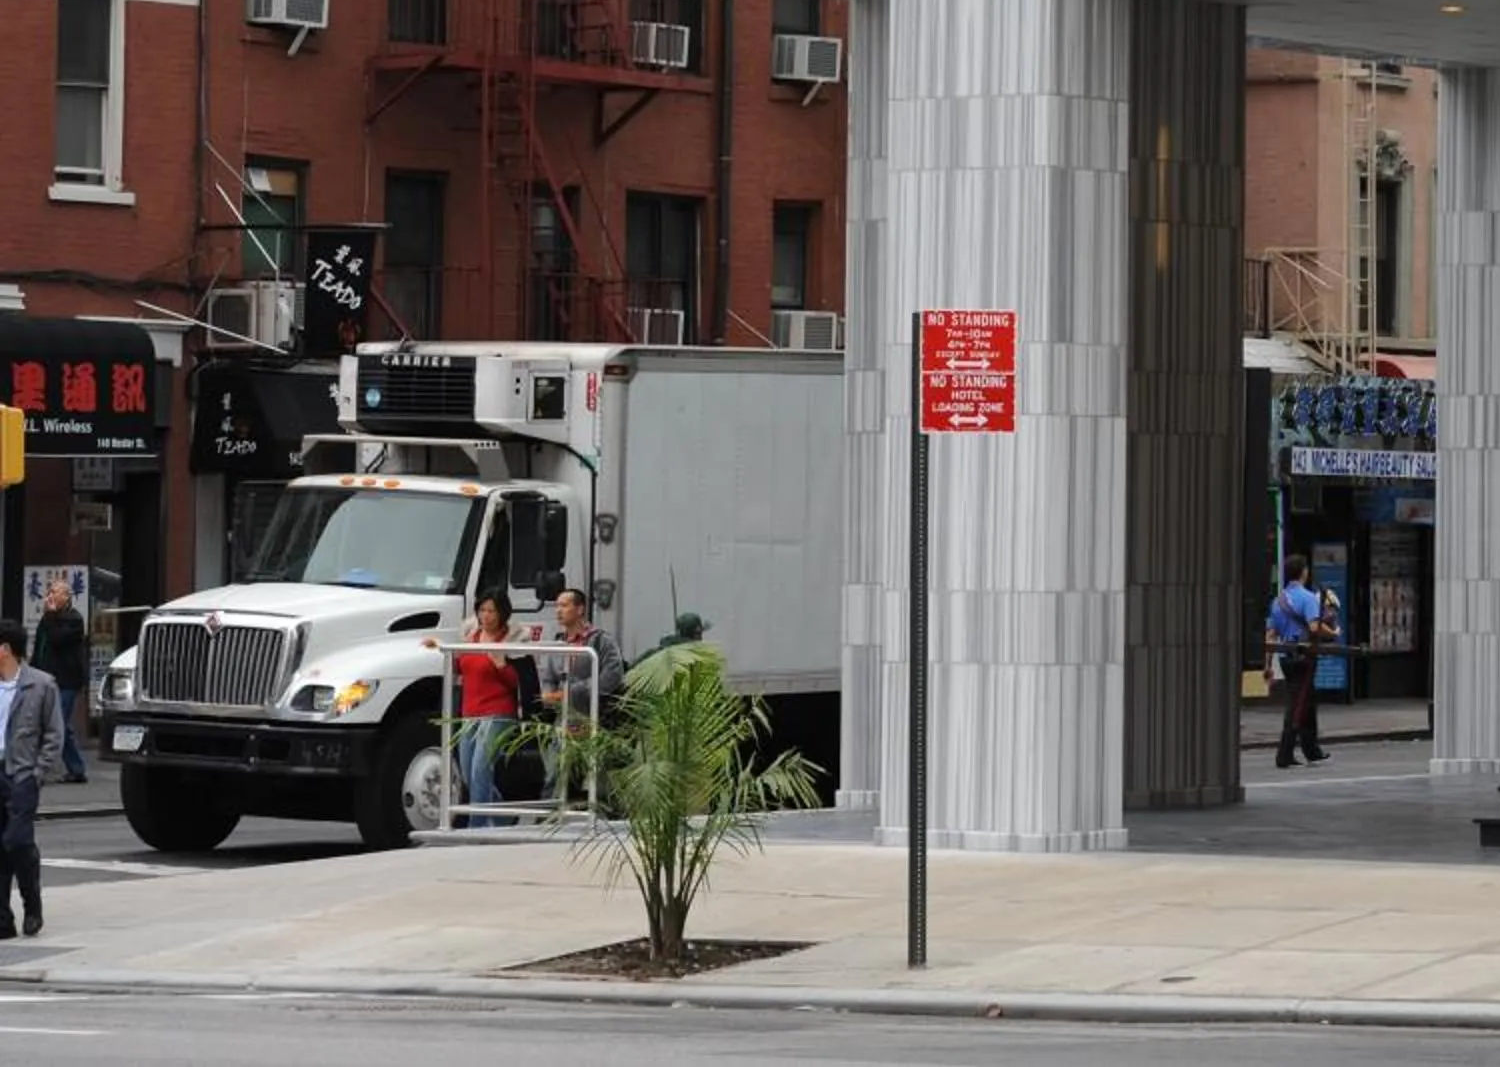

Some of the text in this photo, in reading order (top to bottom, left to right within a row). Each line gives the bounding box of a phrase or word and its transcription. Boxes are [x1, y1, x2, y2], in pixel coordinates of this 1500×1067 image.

[928, 314, 1009, 326] NO STANDING
[930, 376, 1006, 388] NO STANDING
[951, 390, 986, 400] HOTEL
[932, 403, 1004, 413] LOADING ZONE
[43, 417, 93, 433] Wireless
